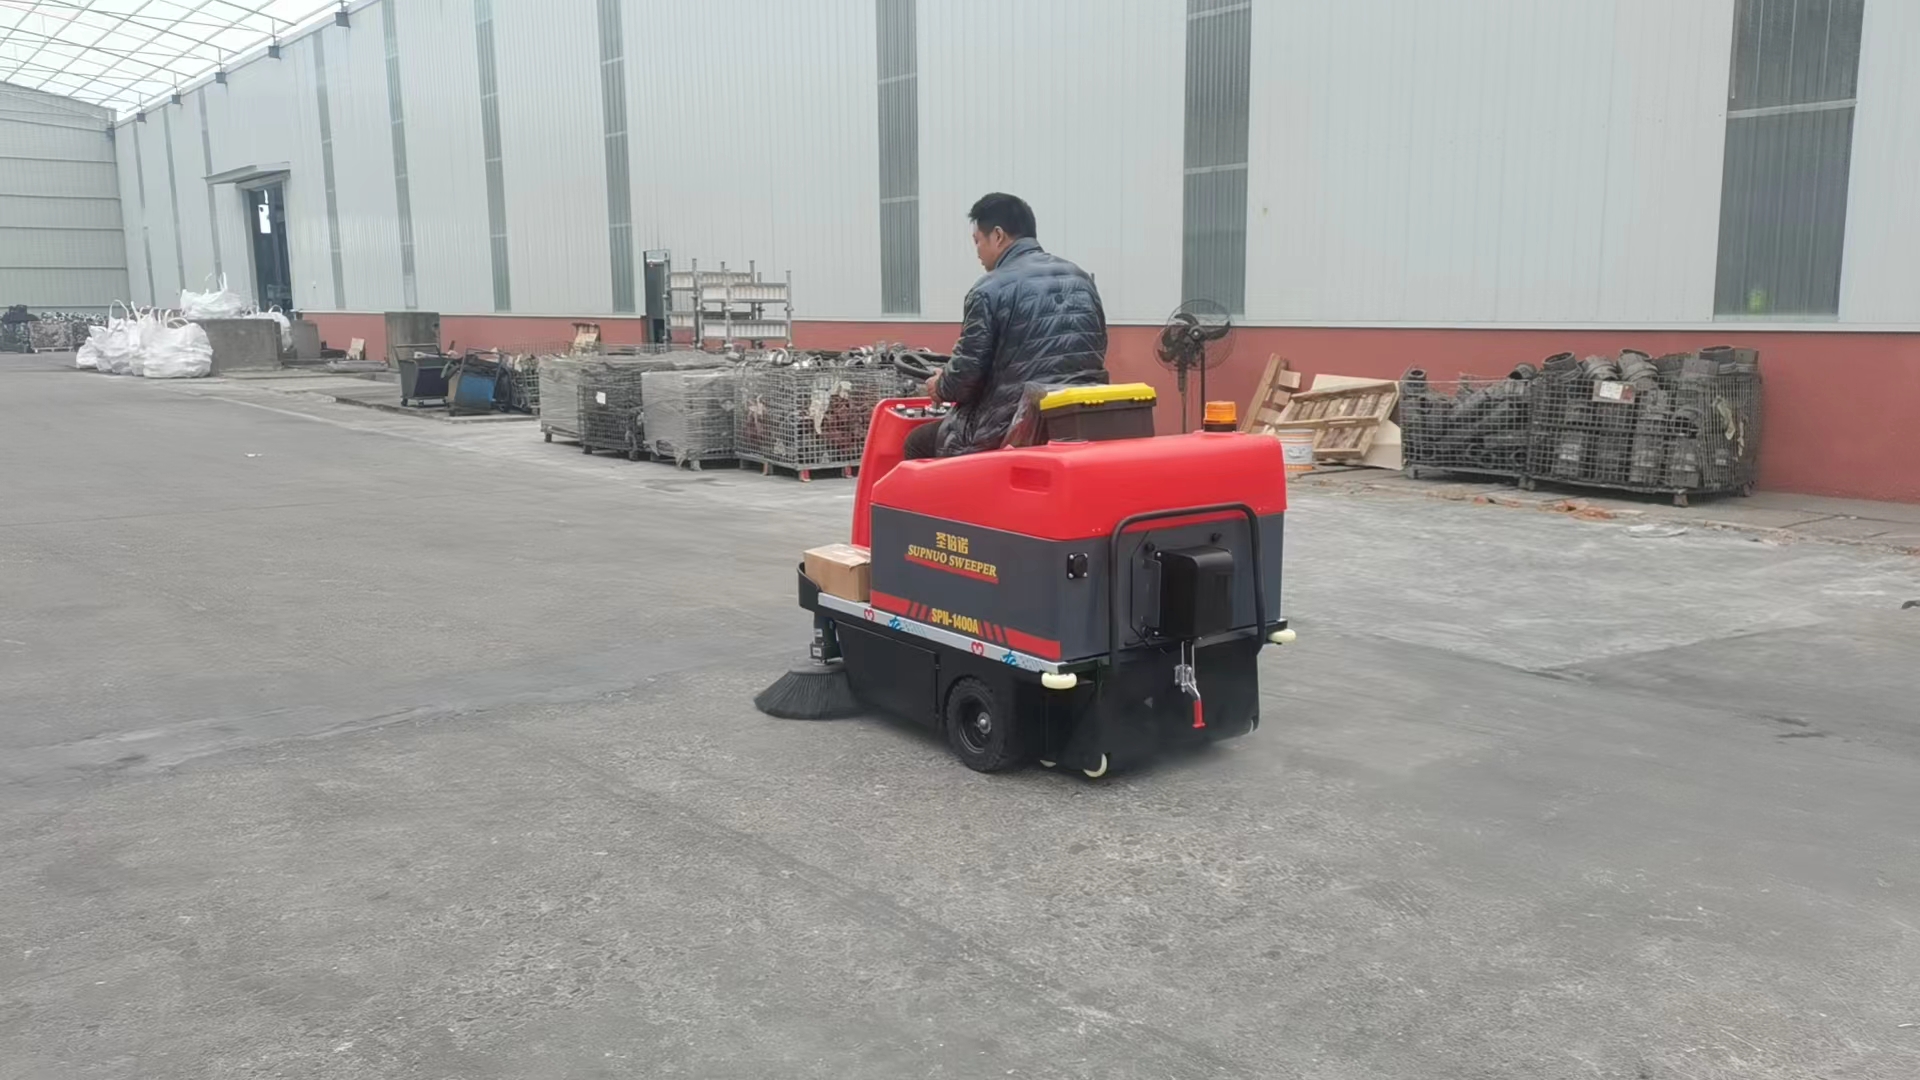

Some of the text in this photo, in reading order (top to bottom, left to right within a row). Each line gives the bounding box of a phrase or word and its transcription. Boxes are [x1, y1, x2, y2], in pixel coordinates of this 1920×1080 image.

[908, 544, 997, 577] SUPNUO SWEEPER
[931, 608, 979, 633] SPN-1400A
